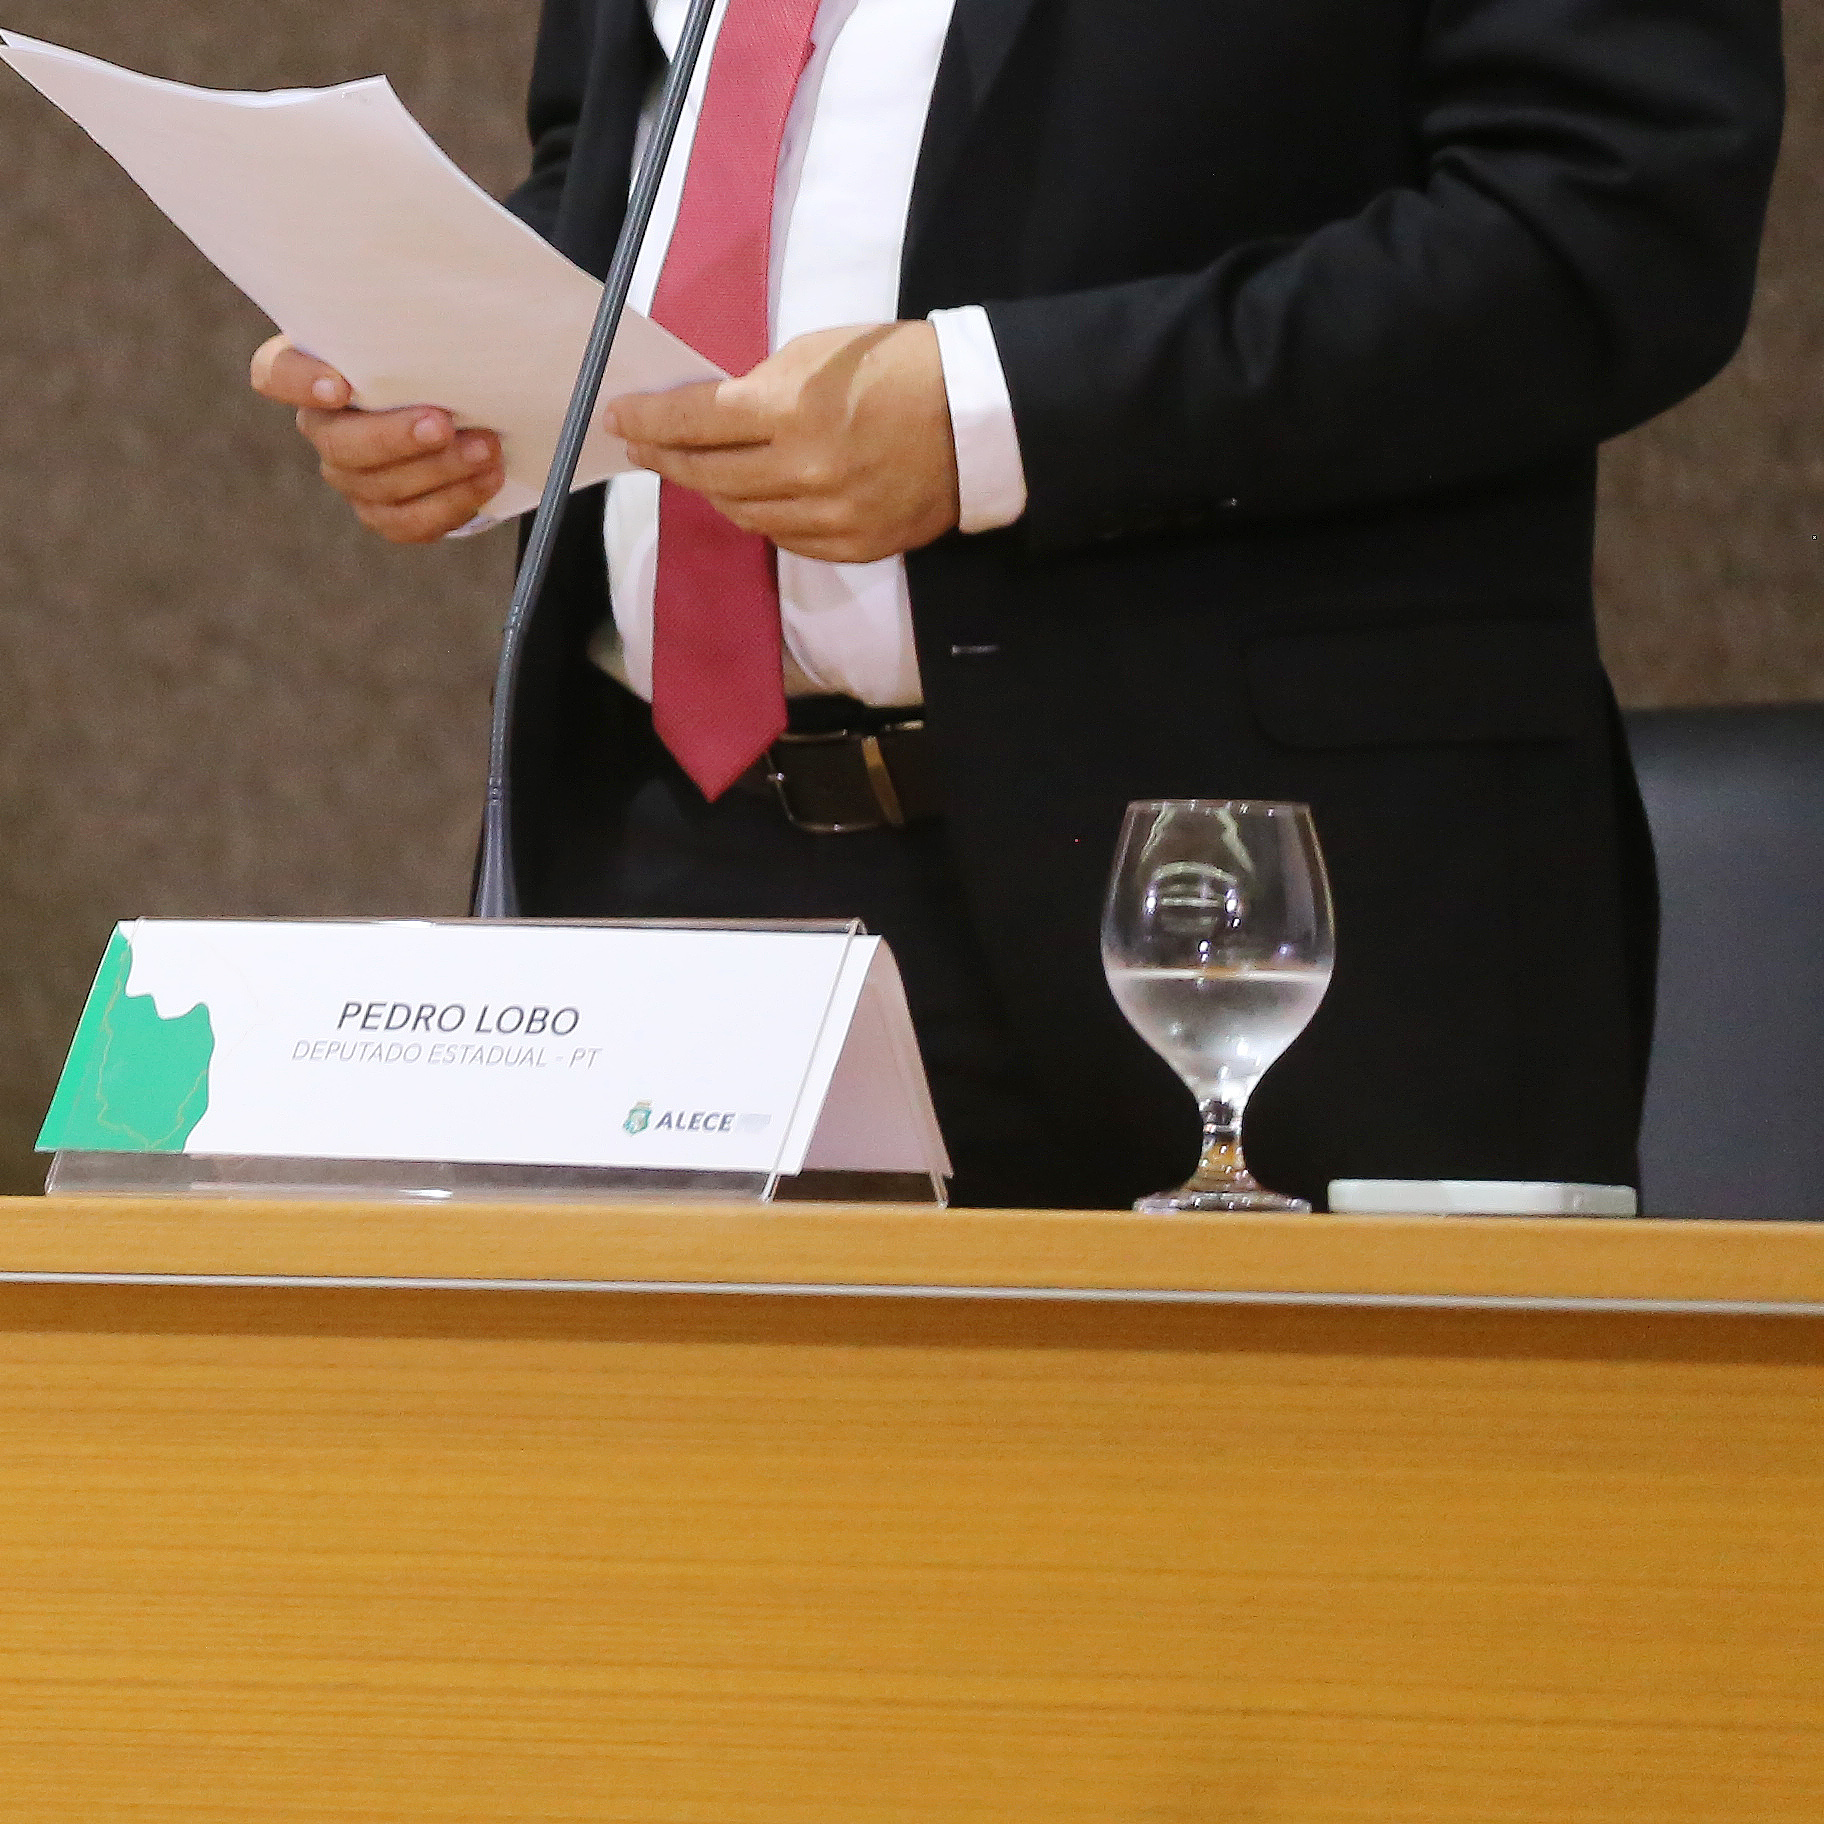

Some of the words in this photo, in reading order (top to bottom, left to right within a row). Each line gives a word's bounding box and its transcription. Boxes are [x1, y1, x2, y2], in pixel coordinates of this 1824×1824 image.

[337, 1001, 466, 1032] PEDRO
[475, 1004, 580, 1036] LOBO
[292, 1039, 422, 1063] DEPUTADO
[428, 1043, 547, 1067] ESTADUAL
[569, 1047, 603, 1069] PT
[654, 1111, 736, 1131] ALECE
